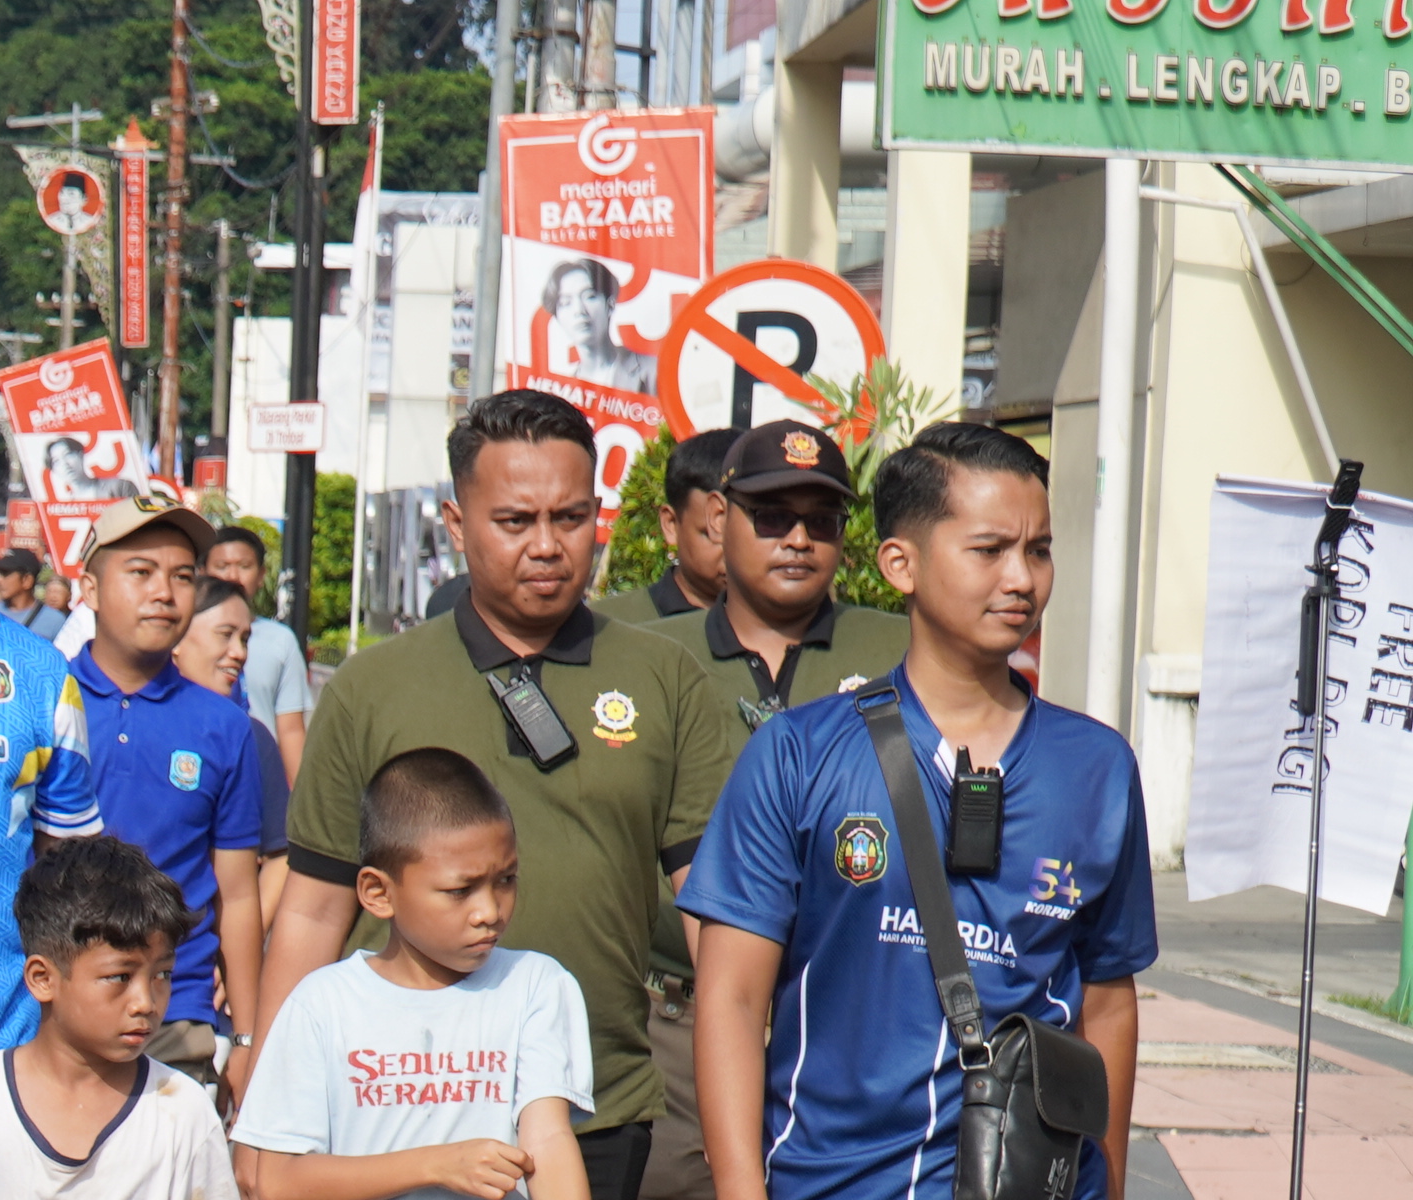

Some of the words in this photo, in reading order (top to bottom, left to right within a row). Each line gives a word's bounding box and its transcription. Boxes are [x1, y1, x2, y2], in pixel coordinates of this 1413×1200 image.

[923, 40, 1084, 96] MURAH
[1126, 51, 1342, 111] LENGKAP
[560, 175, 657, 199] matahari
[540, 196, 674, 230] BAZAAR
[541, 228, 598, 243] BLITAR
[609, 223, 676, 240] SQUARE
[28, 391, 103, 427] BAZAAR
[526, 375, 597, 408] HEMAT
[598, 393, 665, 426] HINGG
[878, 932, 900, 942] HARI
